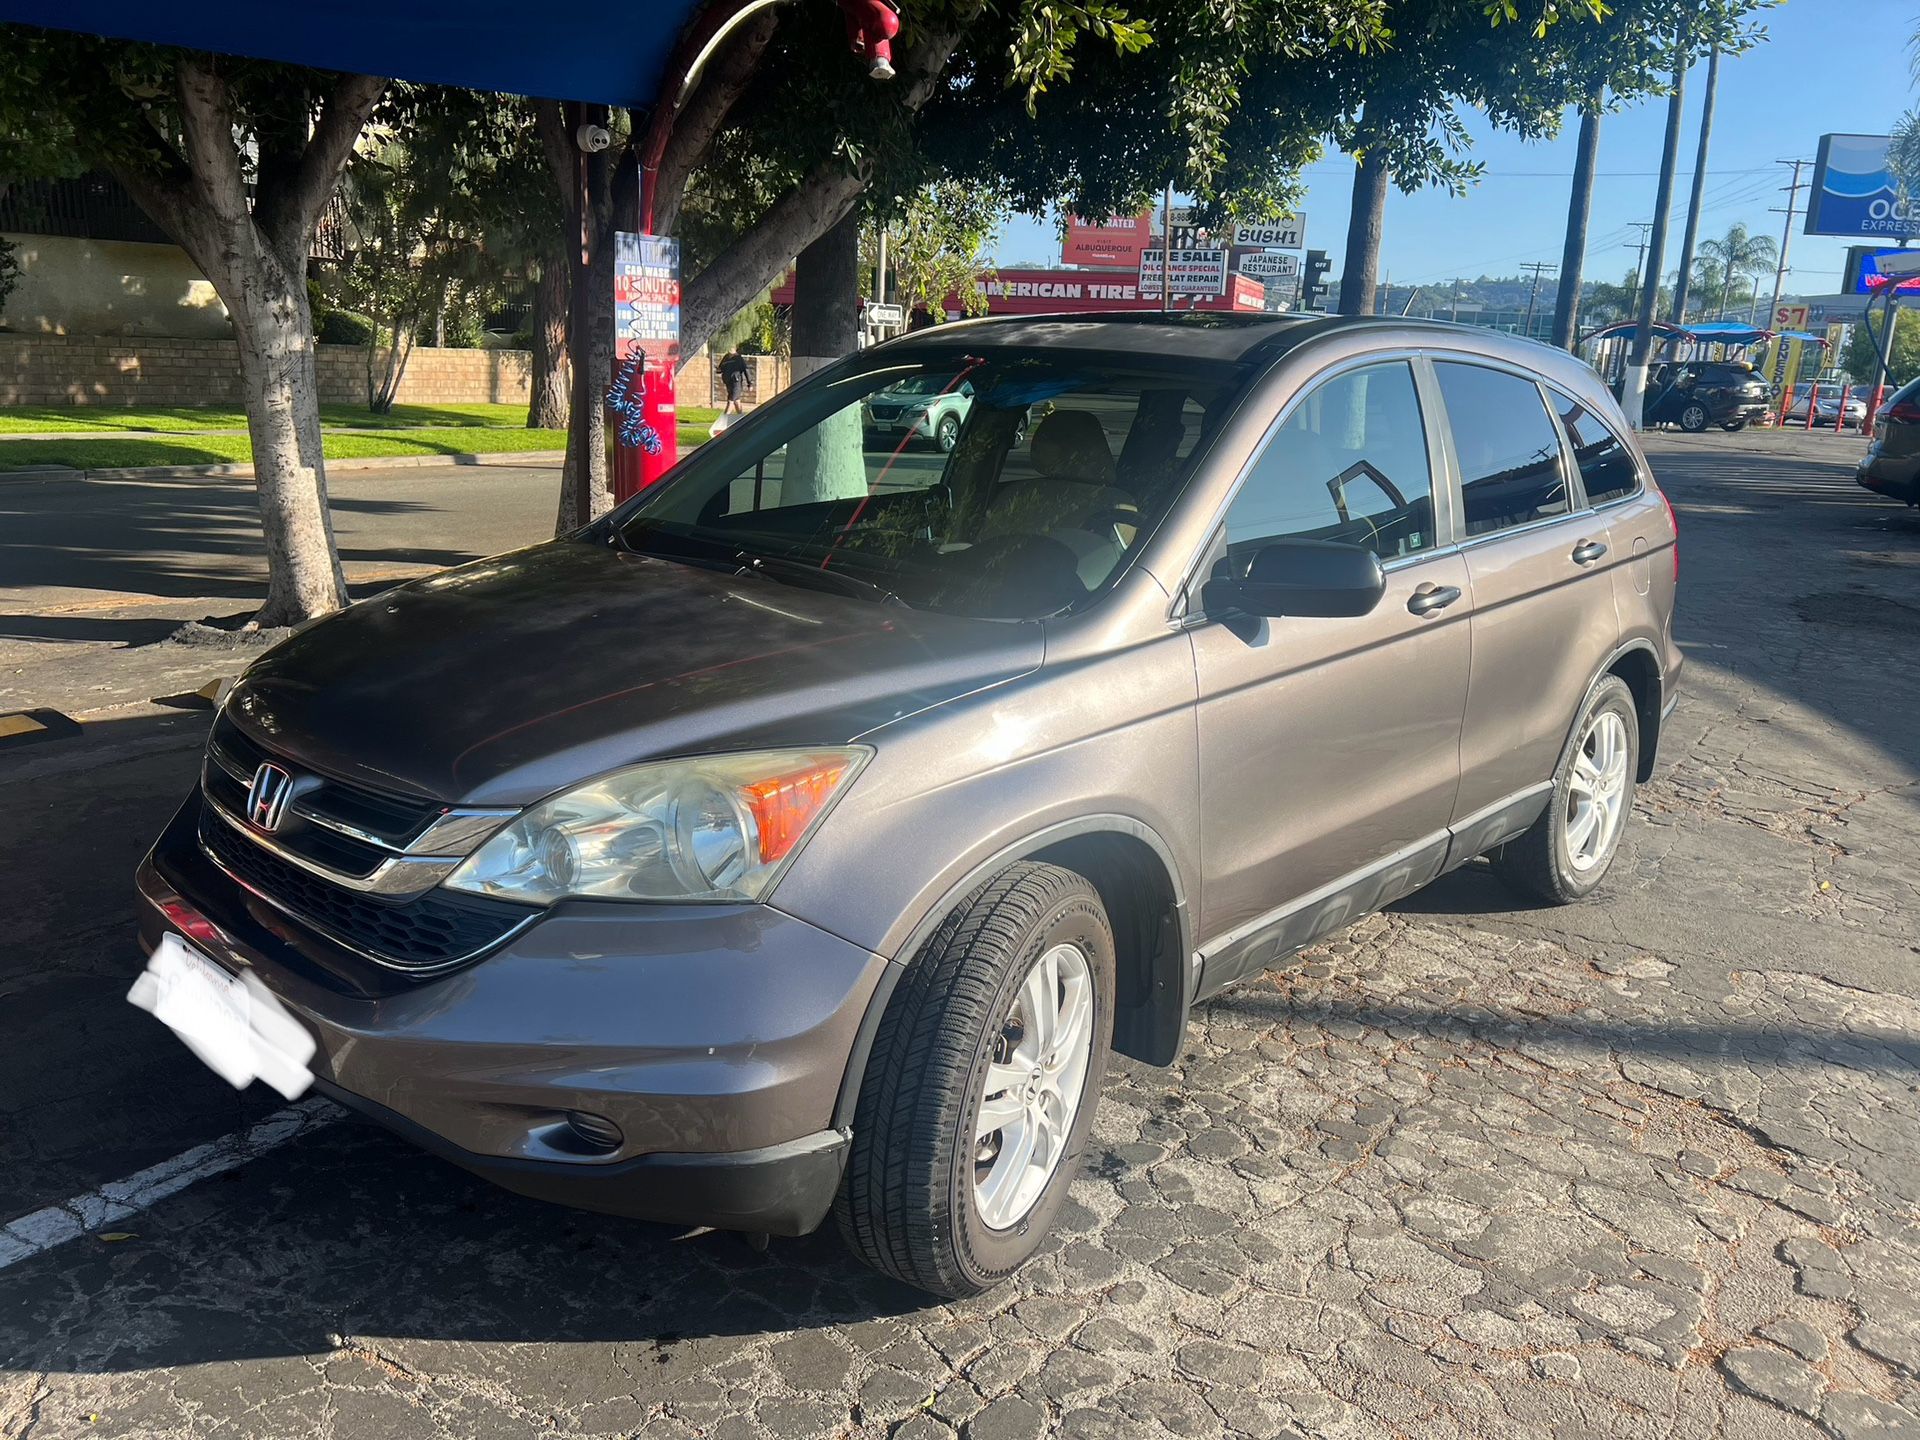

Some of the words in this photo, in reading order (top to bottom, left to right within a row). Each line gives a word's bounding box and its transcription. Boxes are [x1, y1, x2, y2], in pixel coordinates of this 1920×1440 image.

[1238, 229, 1297, 244] SUSHI
[1075, 243, 1133, 252] ALBUQUERQUE
[1182, 251, 1222, 262] SALE
[1248, 255, 1288, 265] JAPANESE
[625, 264, 642, 276] CAR
[644, 267, 670, 278] WASH
[1188, 265, 1220, 273] SPECIAL
[1242, 263, 1293, 274] RESTAURANT
[1187, 275, 1219, 283] REPAIR
[616, 275, 629, 292] 10
[631, 277, 678, 295] MINUTES
[976, 281, 1082, 298] AMERICAN
[1088, 284, 1136, 300] TIRE
[651, 293, 669, 303] SPACE
[877, 311, 887, 319] ONE
[1776, 307, 1806, 324] $7
[1771, 326, 1796, 400] EDNESDAY
